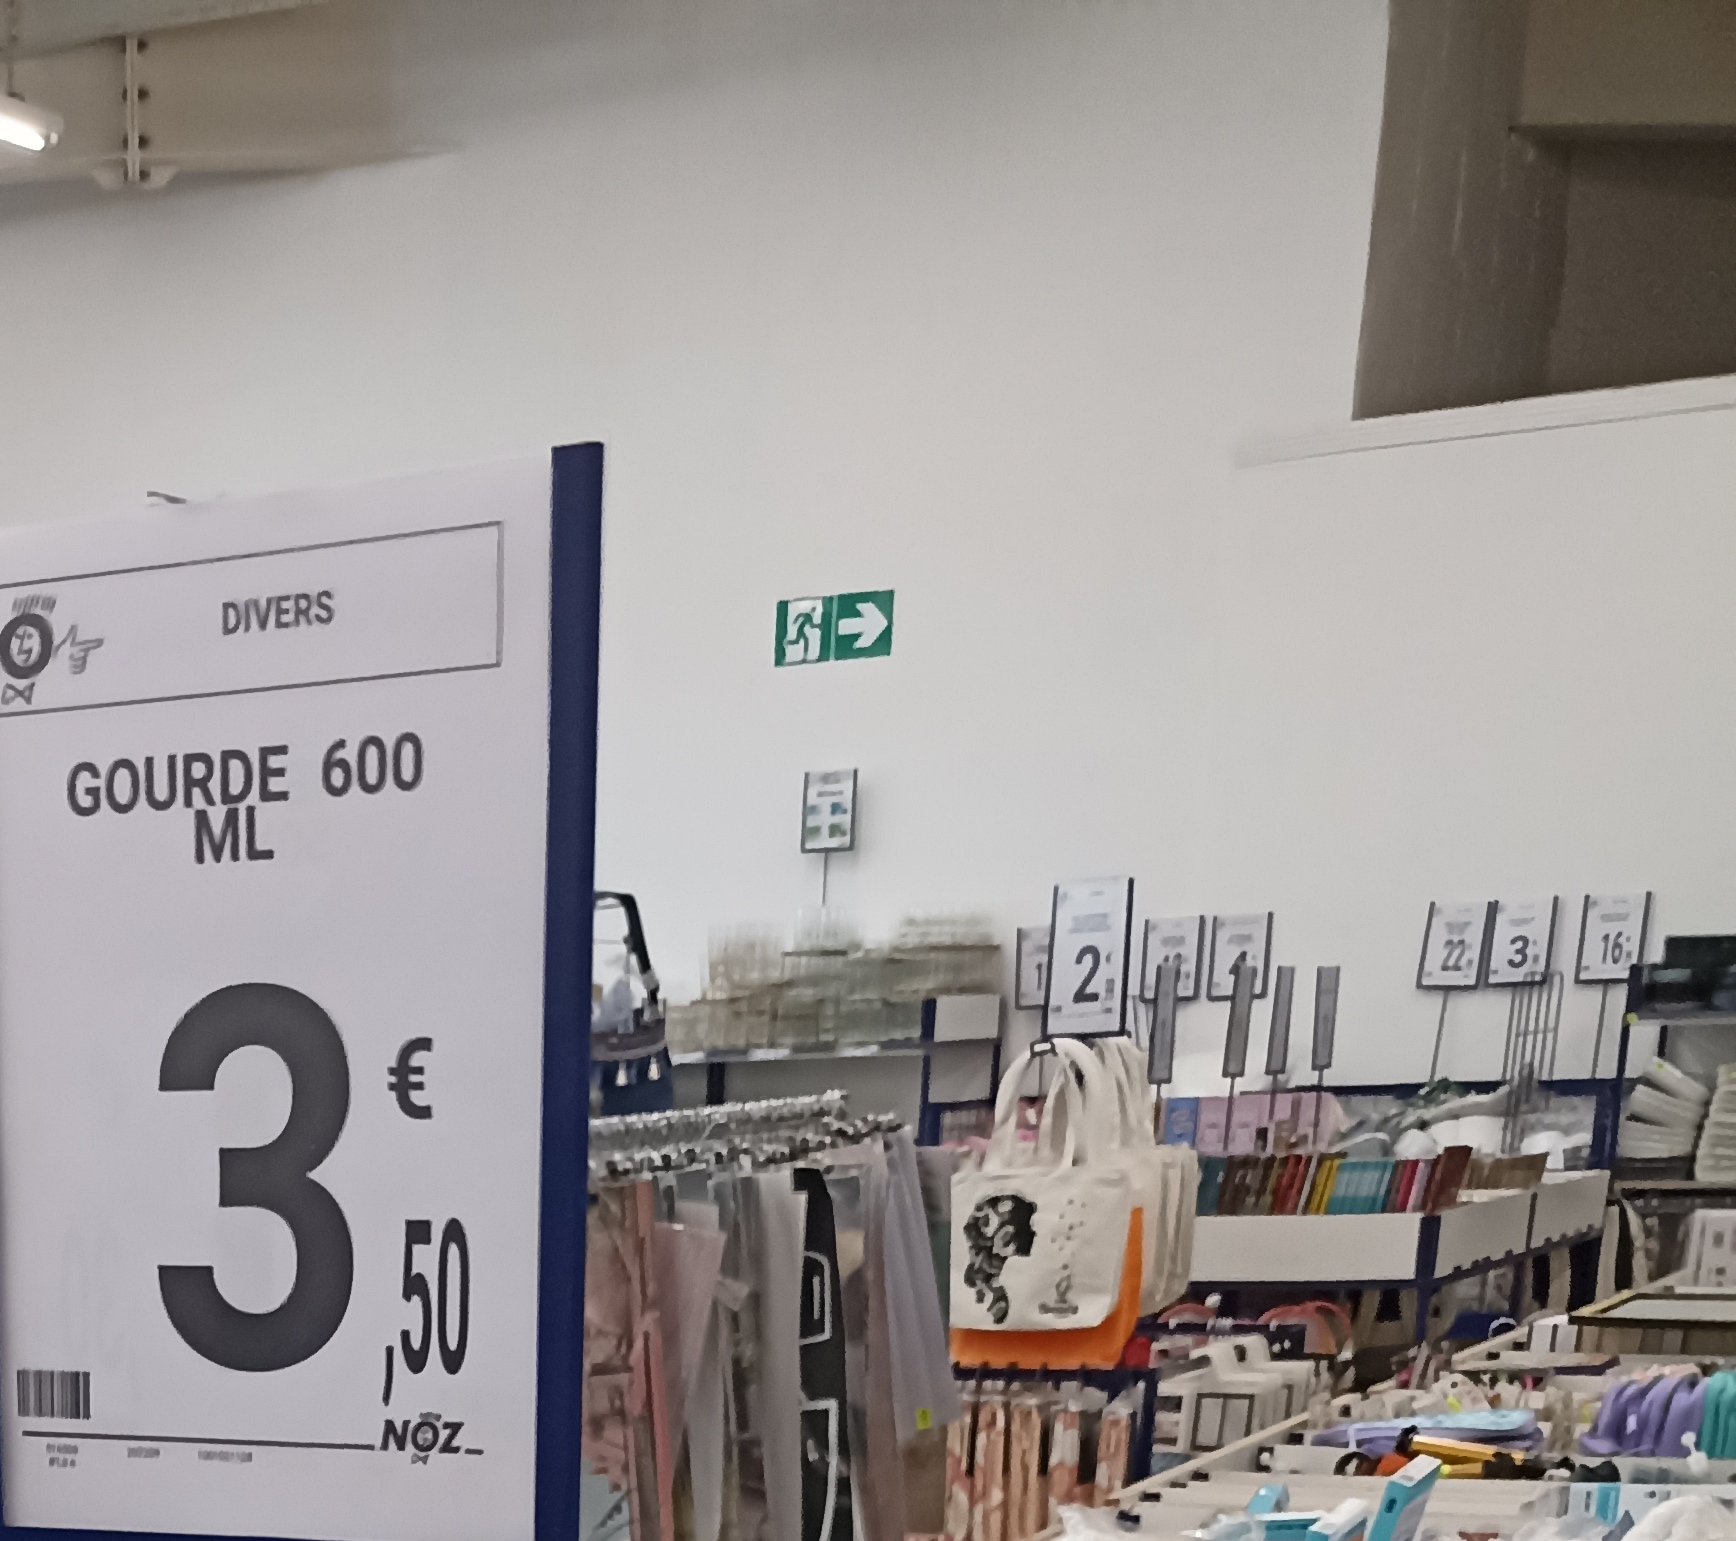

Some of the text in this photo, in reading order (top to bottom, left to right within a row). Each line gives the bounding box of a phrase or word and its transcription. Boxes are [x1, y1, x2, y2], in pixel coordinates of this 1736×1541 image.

[221, 591, 335, 636] DIVERS
[67, 731, 425, 817] GOURDE 600
[194, 804, 275, 865] ML
[1074, 944, 1101, 1004] 2
[1507, 934, 1530, 969] 3
[386, 1037, 434, 1120] €
[158, 982, 354, 1373] 3
[380, 1418, 466, 1456] NOZ
